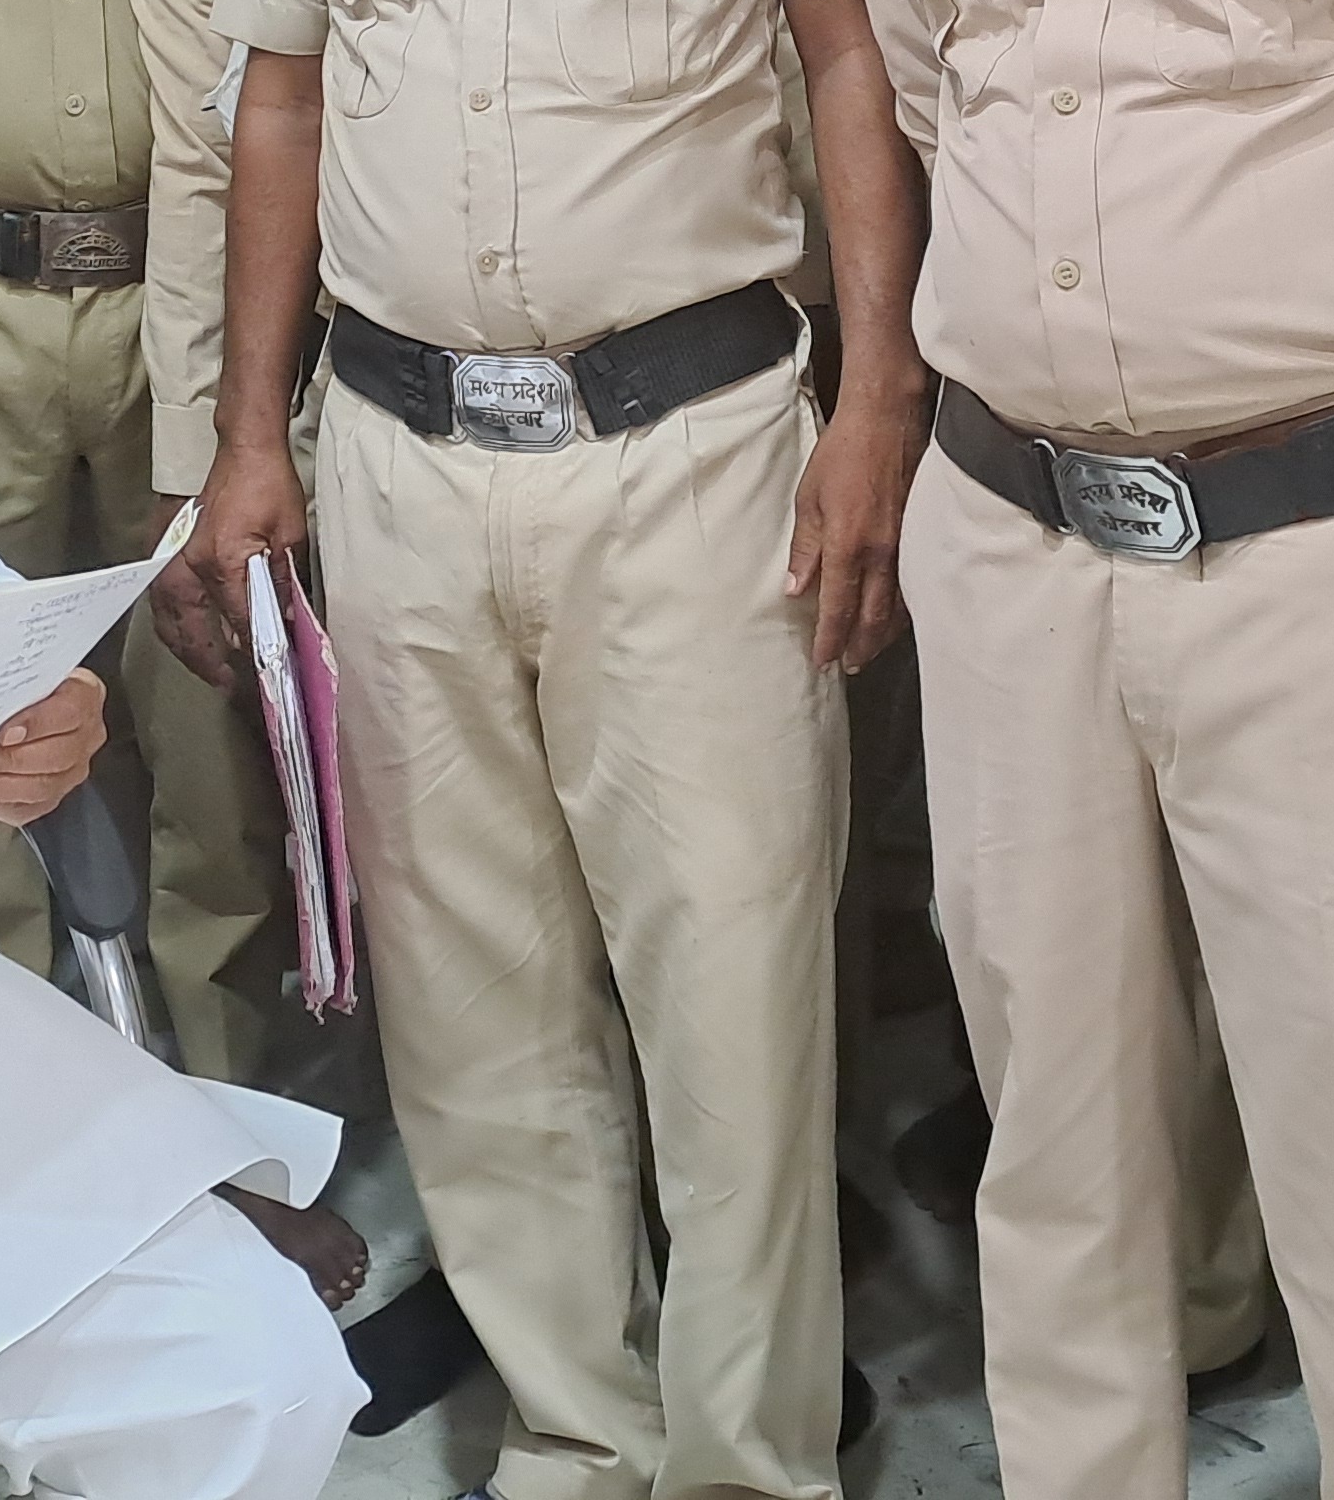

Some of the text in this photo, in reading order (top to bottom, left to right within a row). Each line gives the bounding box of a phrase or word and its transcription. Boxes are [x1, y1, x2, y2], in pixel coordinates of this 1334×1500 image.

[469, 377, 556, 404] मध्य प्रदेश
[478, 403, 546, 429] कोटवार
[1117, 481, 1173, 514] प्रदेश
